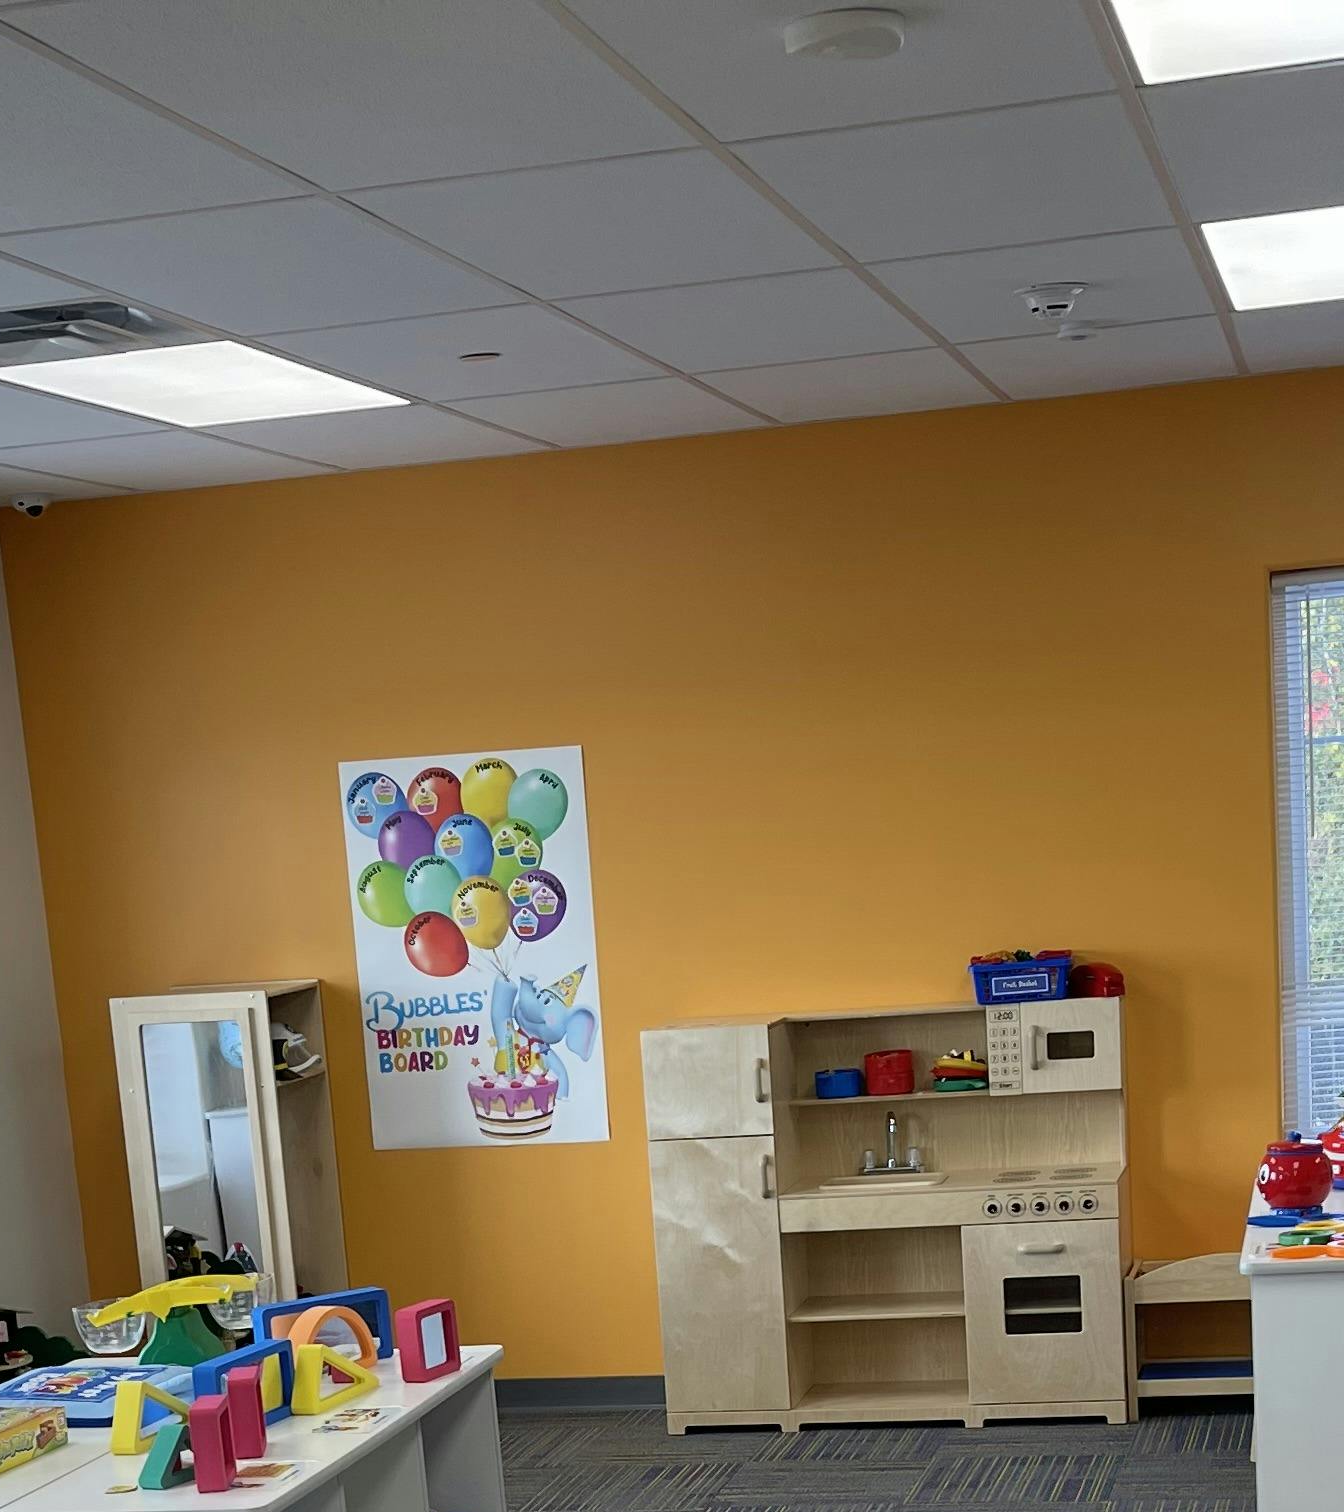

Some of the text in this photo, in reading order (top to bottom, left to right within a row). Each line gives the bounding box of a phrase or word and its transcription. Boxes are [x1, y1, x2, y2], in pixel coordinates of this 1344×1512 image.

[475, 761, 503, 773] March
[416, 770, 456, 787] February
[539, 772, 559, 789] April
[348, 776, 377, 804] January
[385, 815, 402, 830] May
[452, 818, 473, 828] June
[513, 823, 532, 837] July
[359, 865, 382, 894] August
[406, 857, 445, 884] September
[458, 880, 499, 900] November
[408, 915, 432, 946] October
[376, 1024, 480, 1050] BIRTHDAY
[379, 1050, 449, 1074] BOARD
